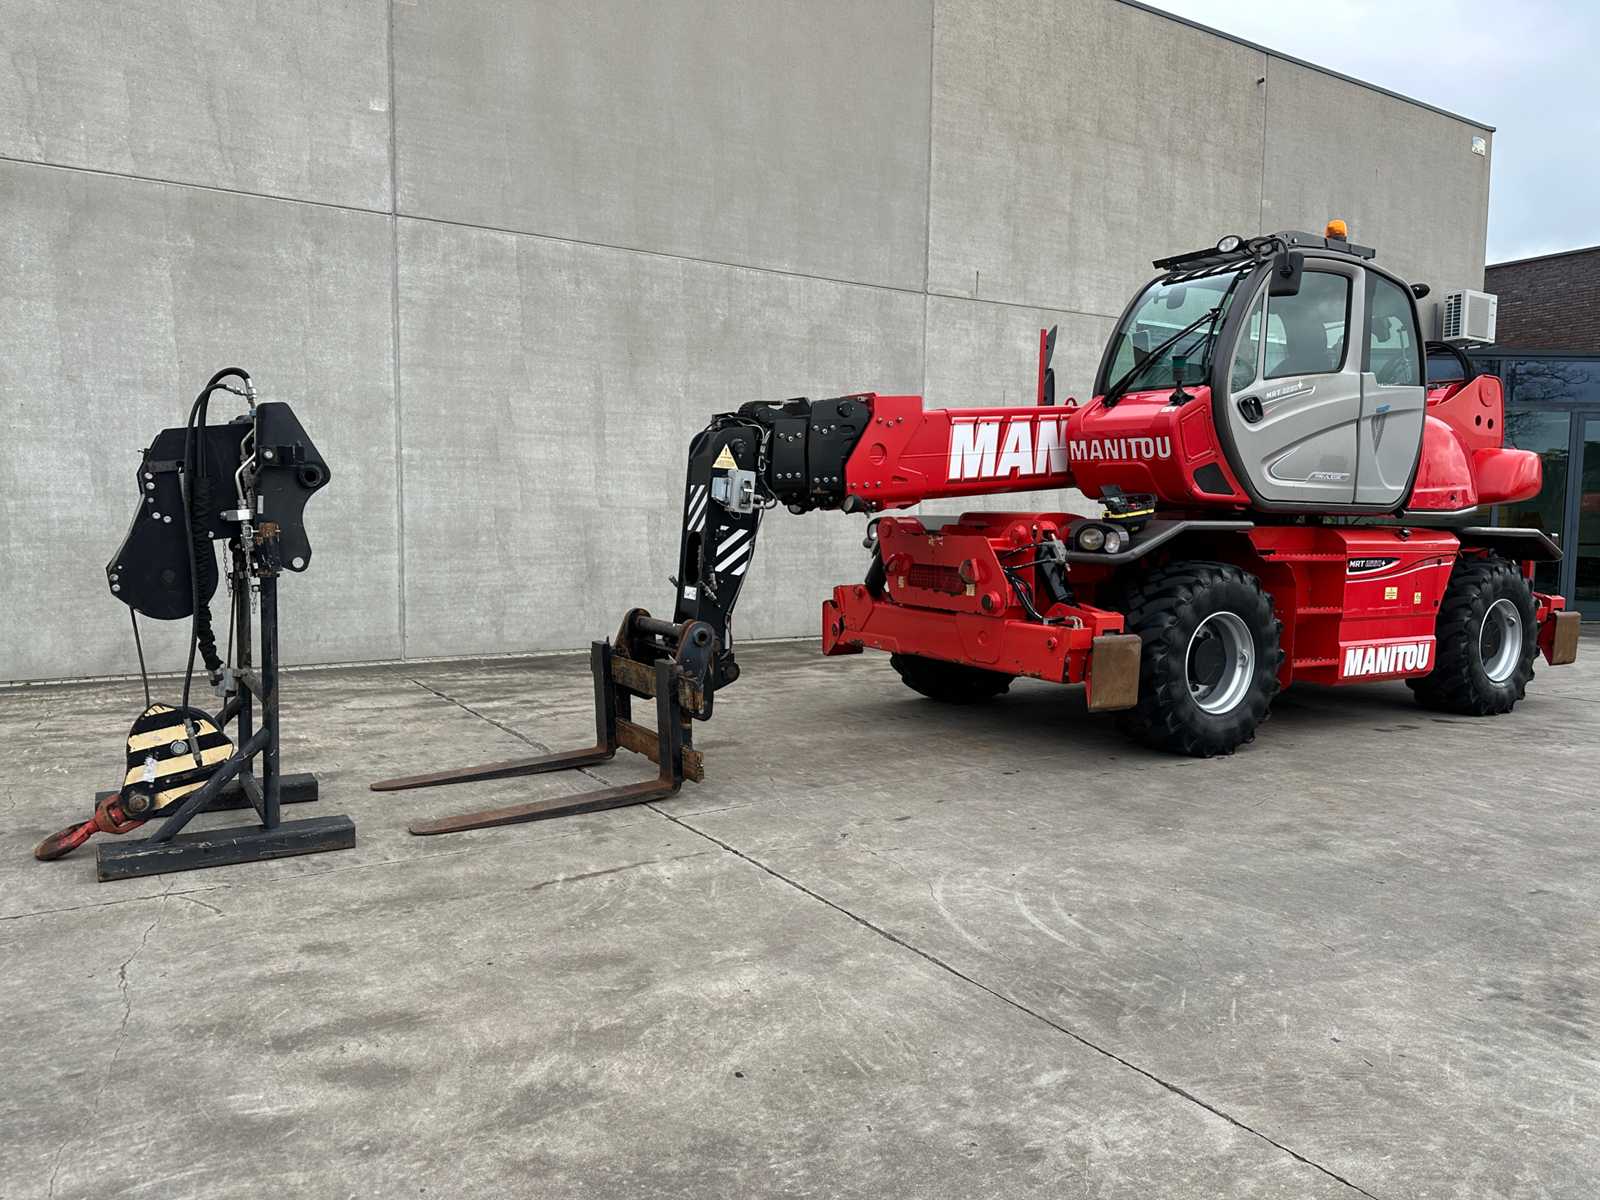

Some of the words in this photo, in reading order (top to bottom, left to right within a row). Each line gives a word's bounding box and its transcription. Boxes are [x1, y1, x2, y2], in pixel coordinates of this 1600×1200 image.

[1069, 435, 1172, 462] MANITOU
[1349, 560, 1366, 568] MRT
[1343, 642, 1431, 677] MANITOU
